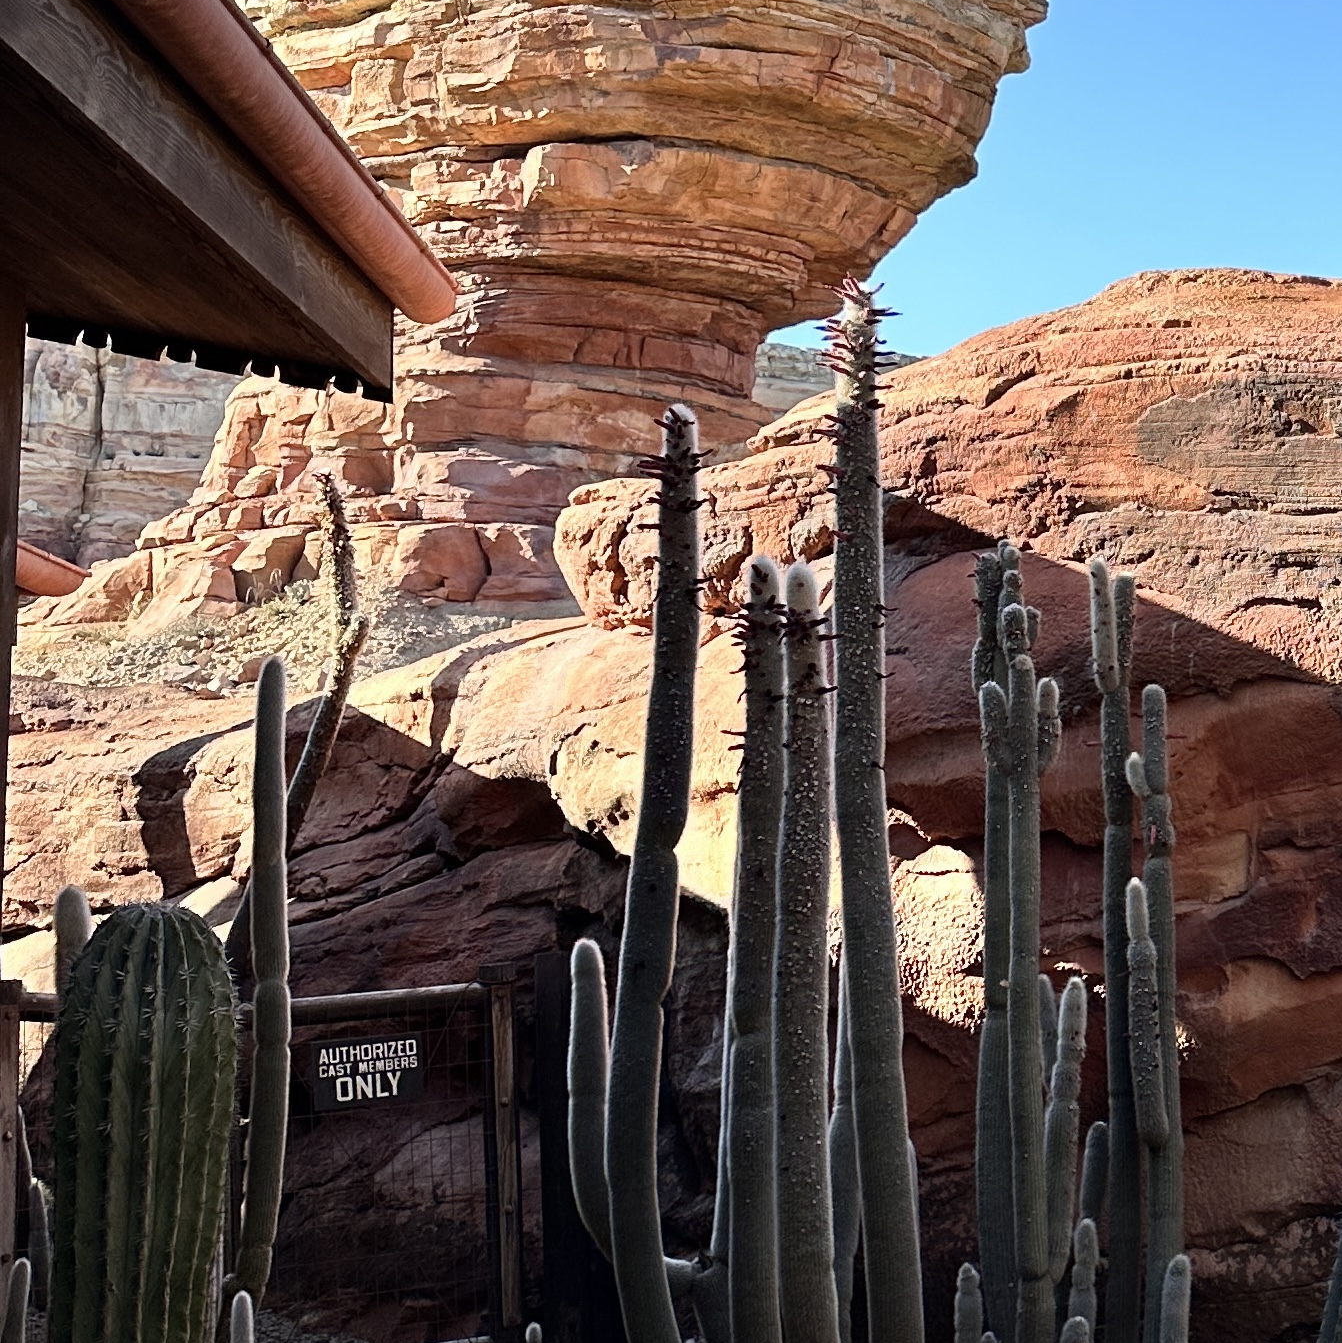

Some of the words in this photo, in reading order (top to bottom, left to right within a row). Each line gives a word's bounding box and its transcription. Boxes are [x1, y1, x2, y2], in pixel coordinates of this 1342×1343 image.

[319, 1039, 417, 1065] AUTHORIZED
[319, 1063, 352, 1077] CAST
[358, 1056, 418, 1073] MEMBERS
[335, 1071, 401, 1102] ONLY
